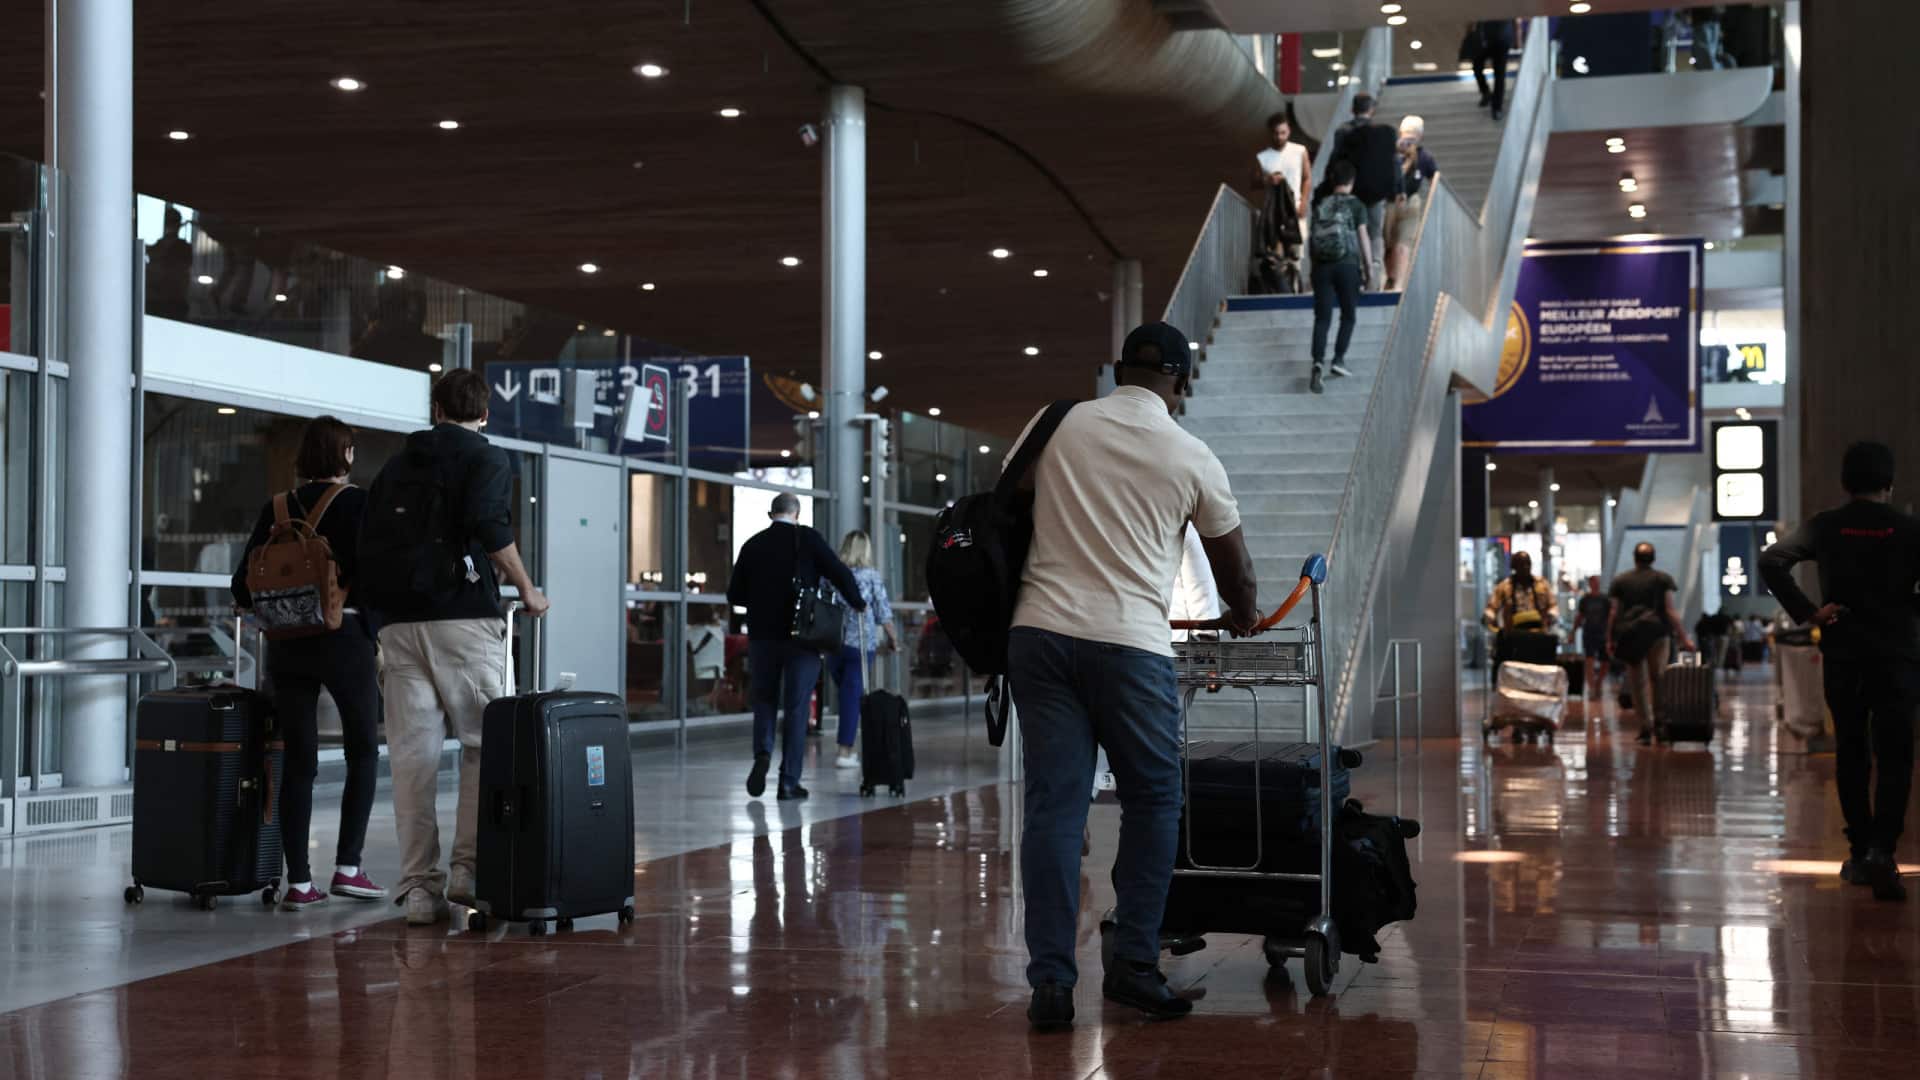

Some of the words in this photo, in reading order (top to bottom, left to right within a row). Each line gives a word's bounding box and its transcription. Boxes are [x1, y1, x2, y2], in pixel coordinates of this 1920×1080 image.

[1539, 308, 1605, 321] MEILLEUR
[1607, 306, 1680, 320] AÉROPORT
[1539, 322, 1612, 335] EUROPÉEN
[679, 364, 721, 399] 31
